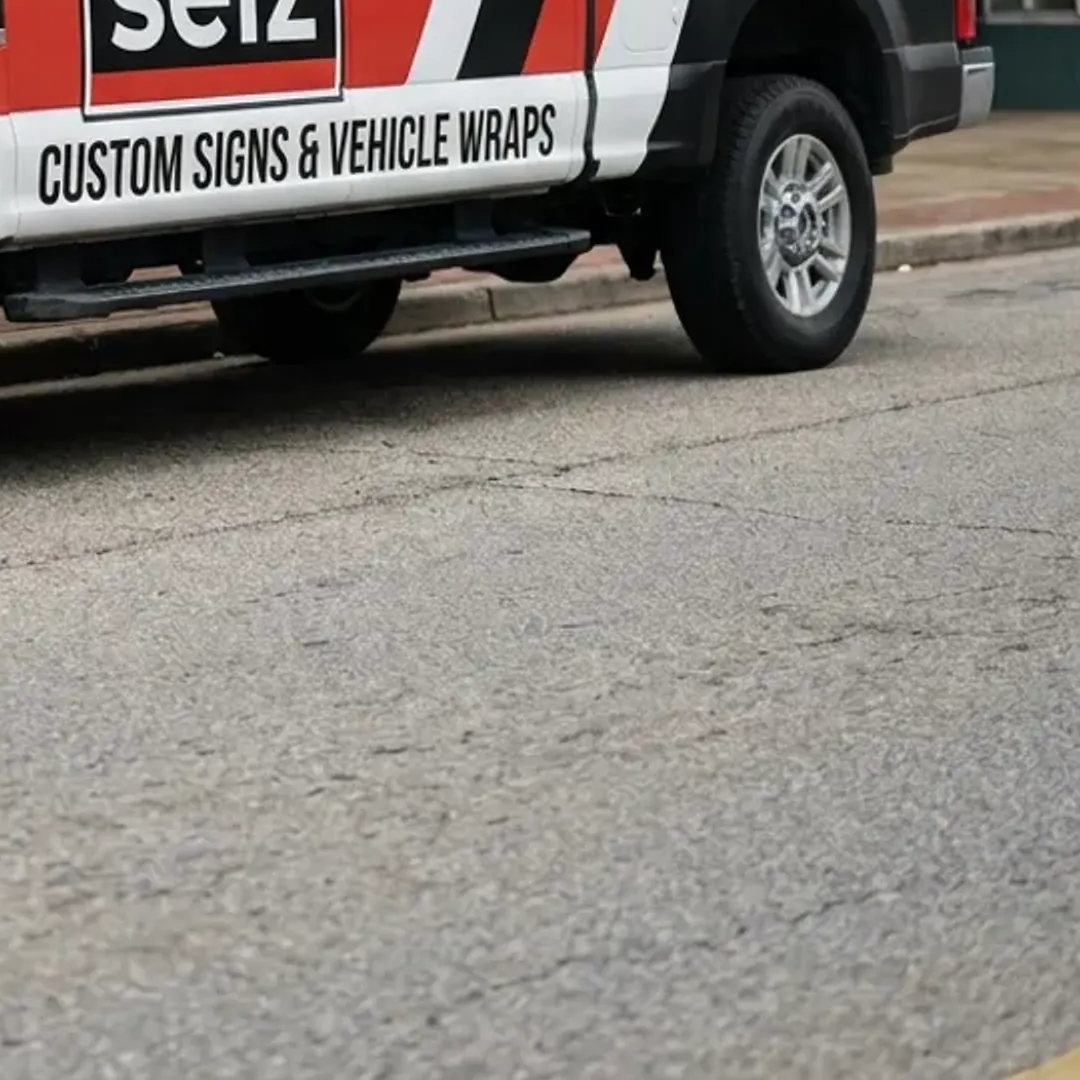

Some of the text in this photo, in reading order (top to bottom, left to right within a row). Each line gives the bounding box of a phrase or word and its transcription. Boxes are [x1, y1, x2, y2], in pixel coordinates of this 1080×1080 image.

[39, 104, 556, 205] CUSTOM SIGNS & VEHICLE WRAPS
